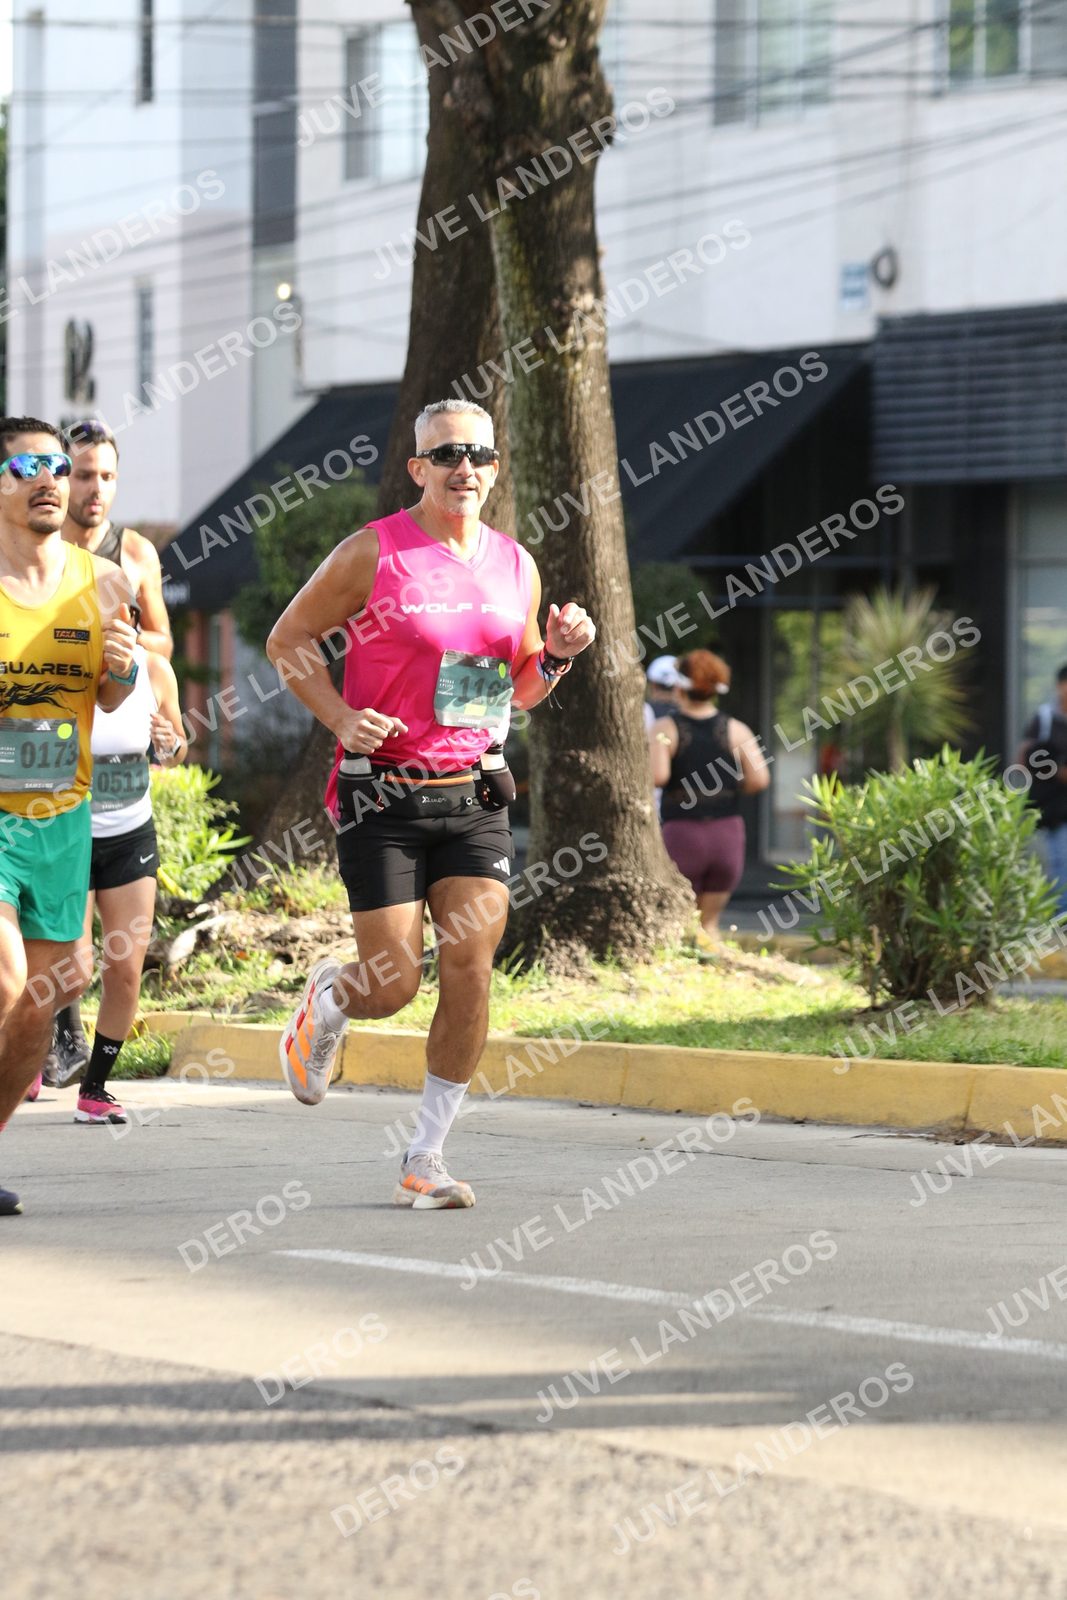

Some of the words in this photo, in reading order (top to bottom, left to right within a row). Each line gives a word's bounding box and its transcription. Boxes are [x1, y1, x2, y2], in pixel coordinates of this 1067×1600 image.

[401, 602, 473, 614] WOLF
[20, 741, 78, 768] 0173
[97, 769, 145, 793] 0511
